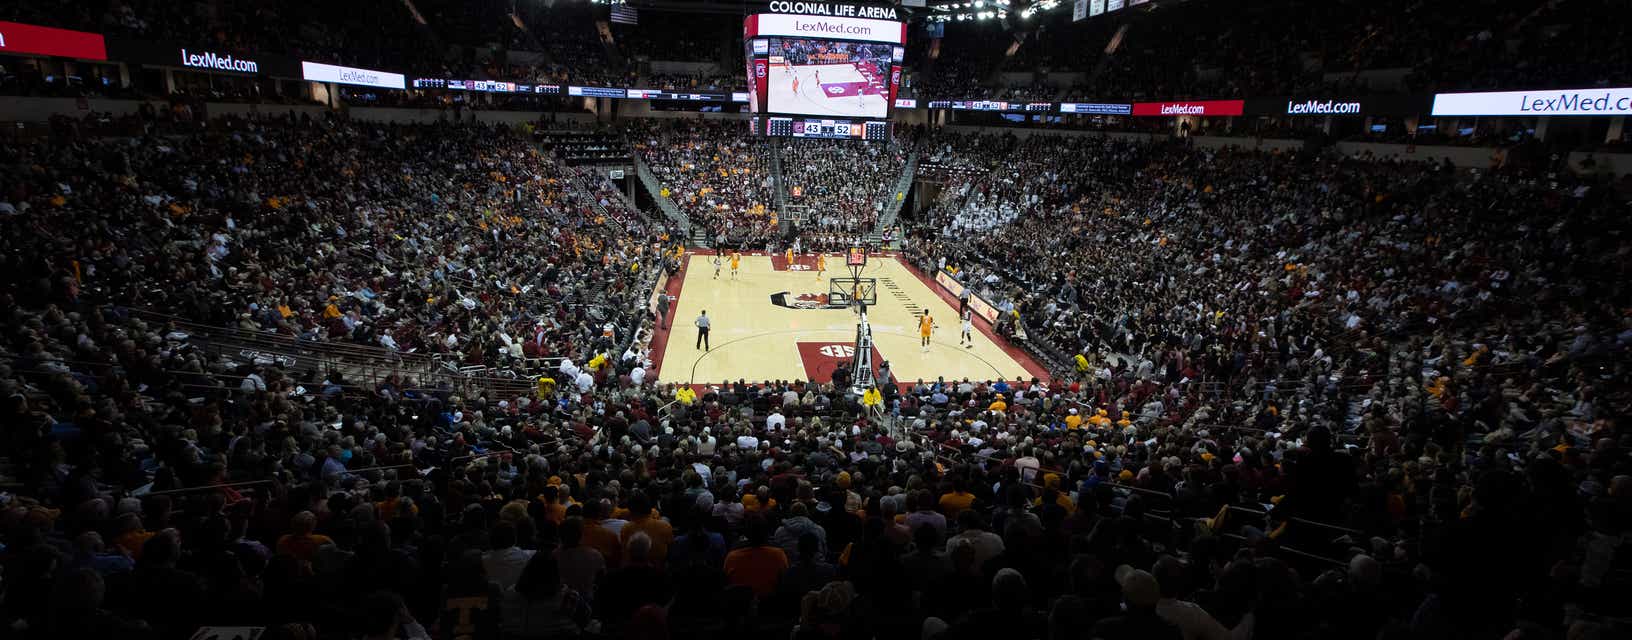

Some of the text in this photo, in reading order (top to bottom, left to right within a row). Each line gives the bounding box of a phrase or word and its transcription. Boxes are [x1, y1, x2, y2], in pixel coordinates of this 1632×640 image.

[769, 1, 897, 19] COLONIAL LIFE ARENA
[795, 20, 871, 35] LexMed.com
[181, 48, 258, 73] LexMed.com
[338, 67, 379, 84] LexMed.com
[1161, 103, 1204, 115] LexMed.com
[1287, 100, 1361, 114] LexMed.com
[1520, 92, 1632, 112] LexMed.c
[806, 124, 819, 133] 43
[837, 125, 849, 134] 52
